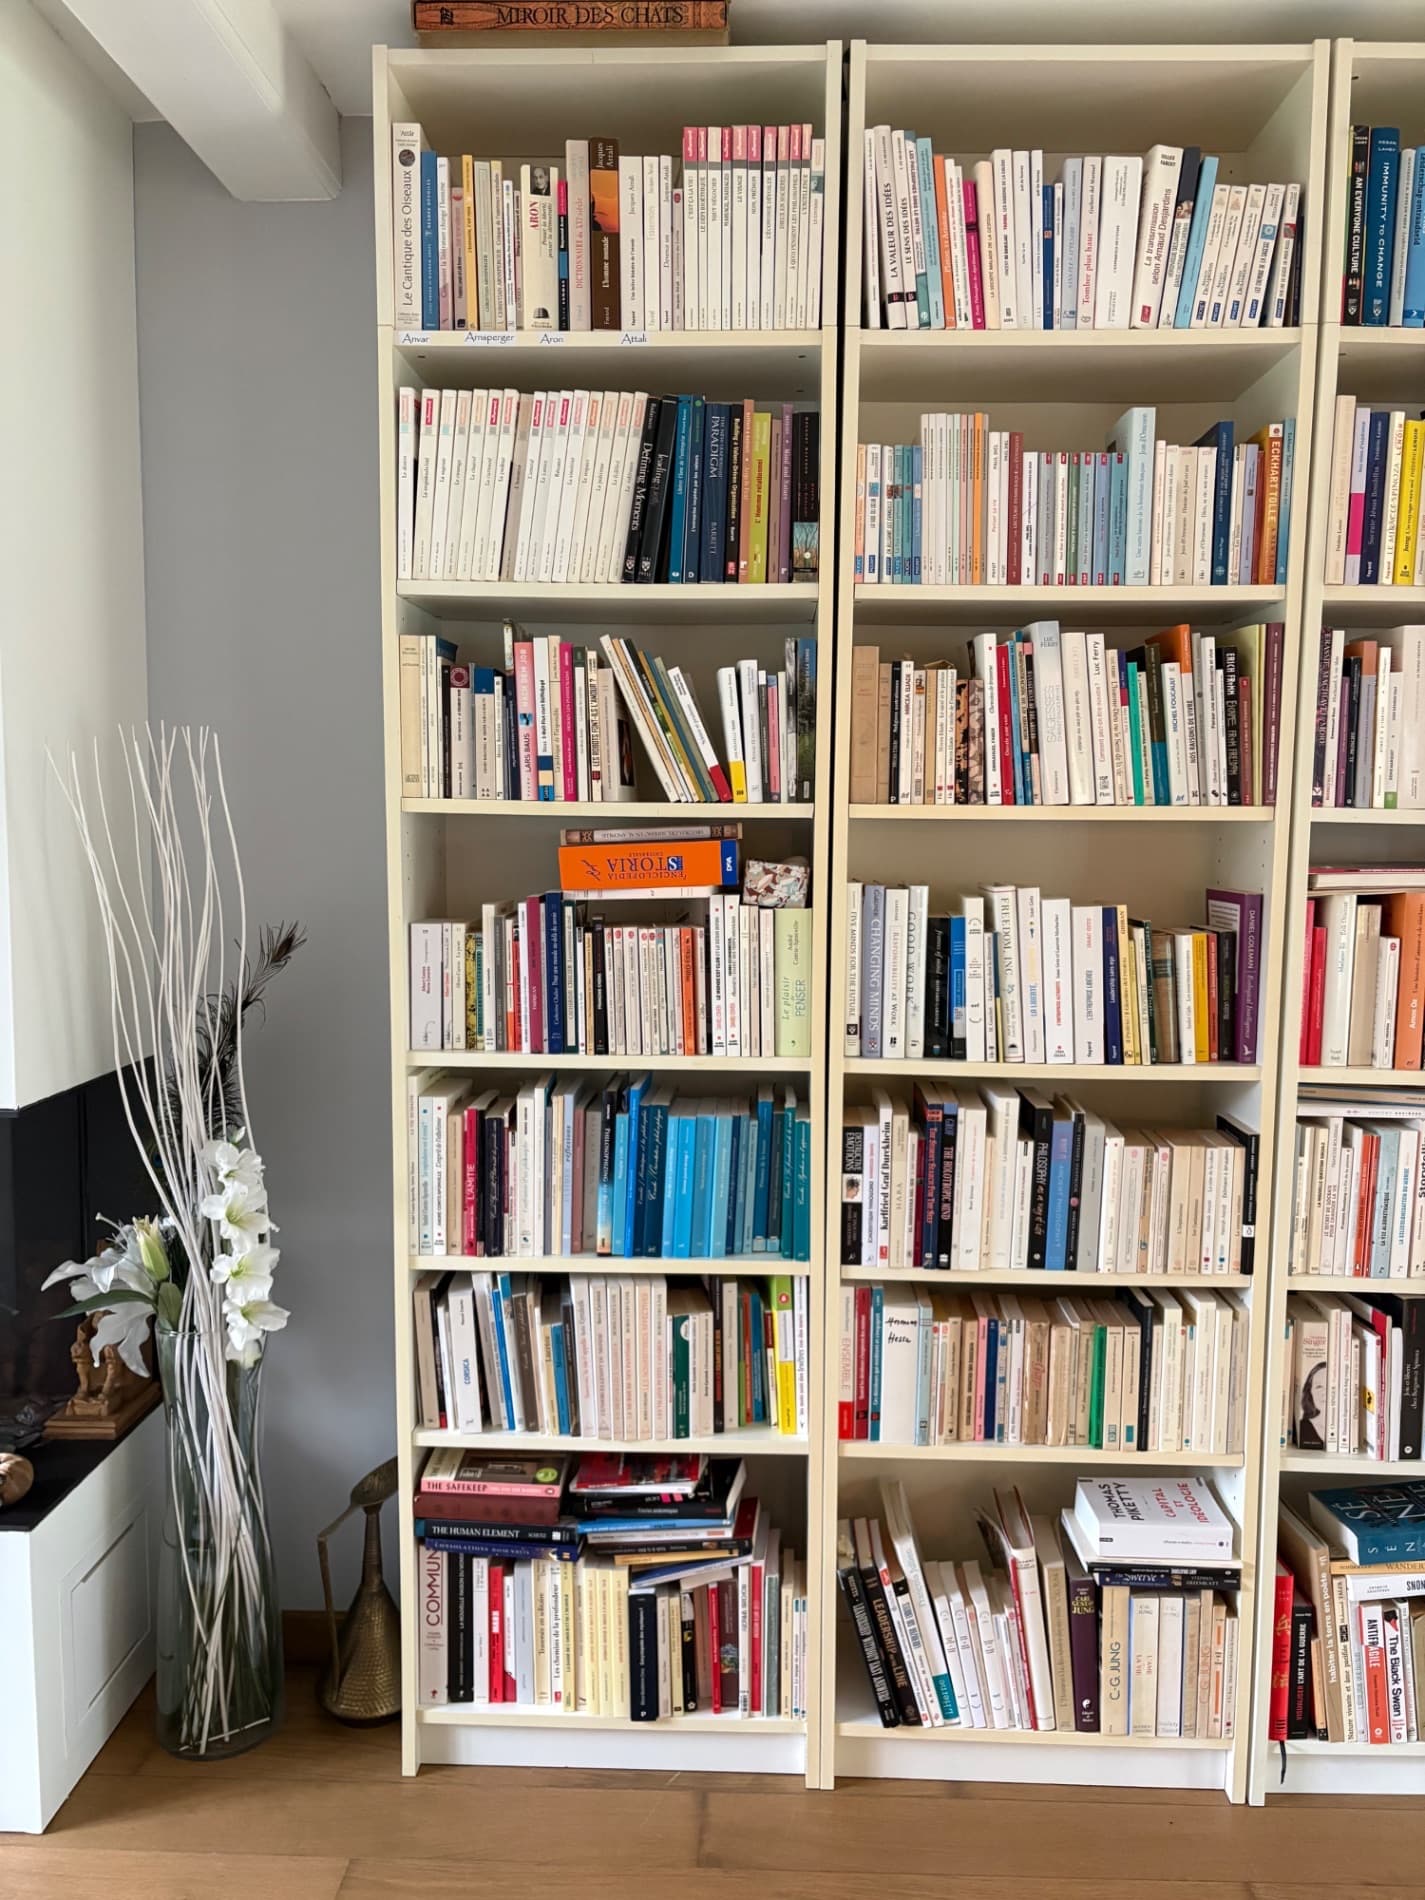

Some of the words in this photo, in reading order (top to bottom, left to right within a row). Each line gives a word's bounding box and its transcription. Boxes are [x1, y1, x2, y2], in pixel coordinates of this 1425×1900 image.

[496, 7, 569, 24] MIROIR
[576, 7, 613, 24] DES
[621, 6, 684, 24] CHATS
[595, 143, 604, 168] Jacques
[606, 145, 614, 167] Attali
[400, 171, 412, 214] Oiseaux
[883, 183, 894, 208] IDÉES
[1355, 177, 1363, 189] AN
[1381, 162, 1390, 221] IMMUNITY
[529, 201, 539, 230] ARON
[887, 210, 896, 228] DES
[900, 197, 909, 218] IDÉES
[1158, 188, 1172, 230] Desjardins
[1352, 190, 1362, 233] EVERYONE
[402, 218, 412, 237] des
[902, 220, 910, 234] DES
[1145, 203, 1159, 254] transmission
[1379, 224, 1385, 236] TO
[888, 230, 898, 265] VALEUR
[903, 236, 911, 253] SENS
[1084, 233, 1093, 251] haut
[1154, 233, 1166, 261] Arnaud
[1351, 235, 1361, 273] CULTURE
[401, 240, 415, 290] Cantique
[904, 254, 912, 264] LE
[1084, 254, 1093, 271] plus
[1144, 256, 1153, 266] La
[1376, 239, 1385, 288] CHANGE
[890, 268, 898, 278] LA
[1152, 263, 1161, 284] selon
[402, 292, 413, 306] Le
[1083, 273, 1093, 304] Tomber
[402, 335, 429, 344] Anvar
[540, 335, 564, 344] Aron
[621, 334, 647, 344] Attali
[709, 416, 720, 478] PARADIGM
[636, 442, 653, 484] Defining
[653, 454, 669, 484] leading
[1269, 441, 1280, 488] ECKHART
[631, 487, 646, 531] Moments
[1268, 492, 1277, 523] TOLLE
[1092, 641, 1100, 660] Ferry
[1169, 677, 1177, 709] FOUCAULT
[1187, 715, 1194, 724] DE
[523, 733, 531, 752] BAUS
[1188, 726, 1196, 751] RAISONS
[523, 754, 531, 772] LARS
[592, 756, 600, 767] LES
[908, 912, 917, 954] GOOD
[1247, 910, 1256, 934] DANIEL
[870, 919, 881, 988] CHANGING
[1247, 936, 1255, 968] GOLEMAN
[1004, 957, 1013, 975] INC
[782, 977, 792, 1006] plaisir
[906, 961, 915, 1005] WORK
[796, 979, 806, 1017] PENSER
[1411, 999, 1418, 1008] Oz
[783, 1009, 790, 1020] Le
[868, 991, 880, 1031] MINDS
[845, 1132, 854, 1171] EMOTIONS
[944, 1146, 954, 1159] THE
[1035, 1142, 1048, 1184] PHILOSOPHY
[880, 1172, 890, 1189] Graf
[462, 1358, 471, 1385] CORSICA
[427, 1482, 442, 1490] THE
[446, 1483, 488, 1492] SAFEKEEP
[1098, 1484, 1126, 1519] THOMAS
[1113, 1482, 1144, 1521] PIKETTY
[1152, 1488, 1176, 1518] CAPITAL
[1173, 1500, 1184, 1508] ET
[1177, 1483, 1212, 1524] IDÉOLOGIE
[432, 1526, 449, 1534] THE
[450, 1527, 481, 1536] HUMAN
[483, 1528, 520, 1538] ELEMENT
[1320, 1572, 1331, 1599] poète
[552, 1584, 560, 1620] profondeur
[1324, 1600, 1332, 1612] en
[872, 1598, 897, 1654] LEADERSHIP
[1297, 1623, 1307, 1648] GUERRE
[1325, 1614, 1335, 1638] terre
[852, 1602, 872, 1636] LEADERSHIP
[863, 1636, 878, 1662] WITHOUT
[872, 1677, 890, 1702] ANSWERS
[1298, 1649, 1306, 1657] LA
[1327, 1640, 1335, 1648] la
[1340, 1644, 1350, 1668] pacifiée
[1367, 1619, 1380, 1668] ANTIFRAGILE
[1389, 1635, 1399, 1655] The
[1109, 1642, 1121, 1673] JUNG
[1298, 1658, 1306, 1666] DE
[1328, 1649, 1338, 1683] habiter
[893, 1666, 907, 1688] LINE
[1297, 1668, 1305, 1684] L'ART
[1342, 1670, 1350, 1683] âme
[1390, 1658, 1401, 1685] Black
[1345, 1694, 1353, 1716] vivante
[1392, 1688, 1402, 1717] Swan
[1347, 1719, 1355, 1740] Nature
